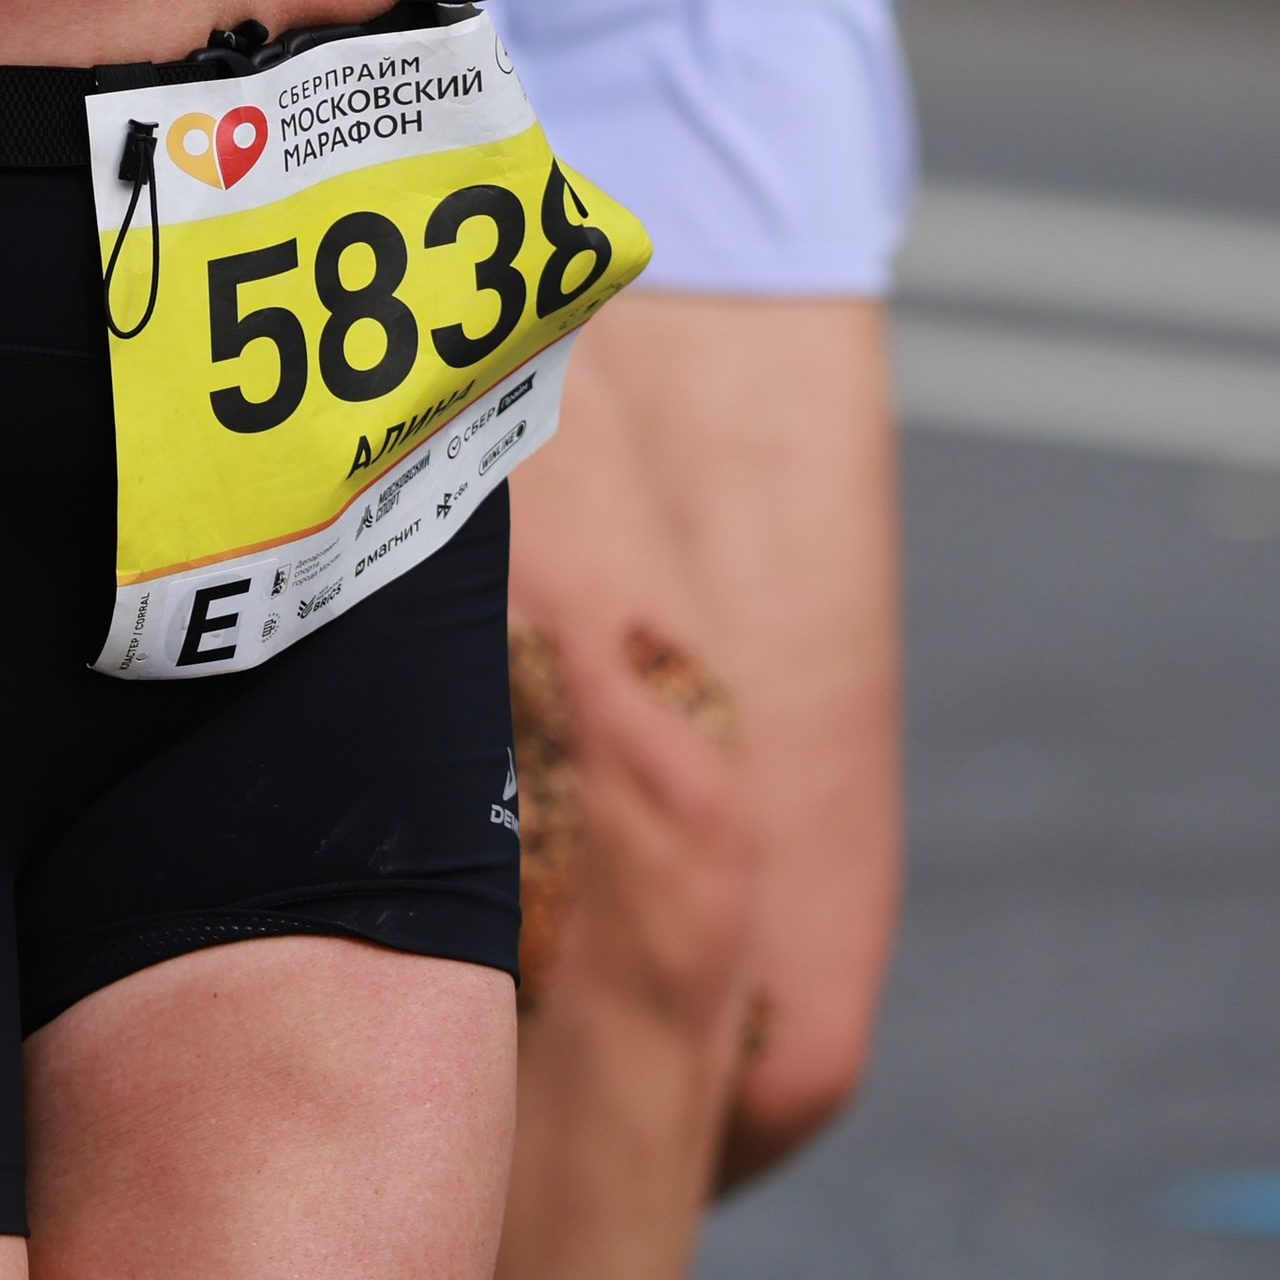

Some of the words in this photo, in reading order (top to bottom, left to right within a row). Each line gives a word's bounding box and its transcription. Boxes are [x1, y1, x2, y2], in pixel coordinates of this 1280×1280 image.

[278, 56, 421, 110] СБЕРПРАЙМ
[280, 65, 483, 142] МОСКОВСКИЙ
[283, 110, 423, 173] МАРАФОН
[207, 156, 613, 434] 5838
[345, 378, 476, 481] АЛИНА
[463, 406, 496, 442] СБЕР
[481, 430, 516, 470] WINLINE
[375, 489, 401, 523] СПОРТ
[377, 449, 431, 507] МОСКОВСКИЙ
[291, 571, 318, 588] города
[312, 583, 342, 613] BRICS
[118, 637, 140, 671] КЛАСТЕР
[135, 591, 150, 630] CORRAL
[175, 577, 252, 667] E
